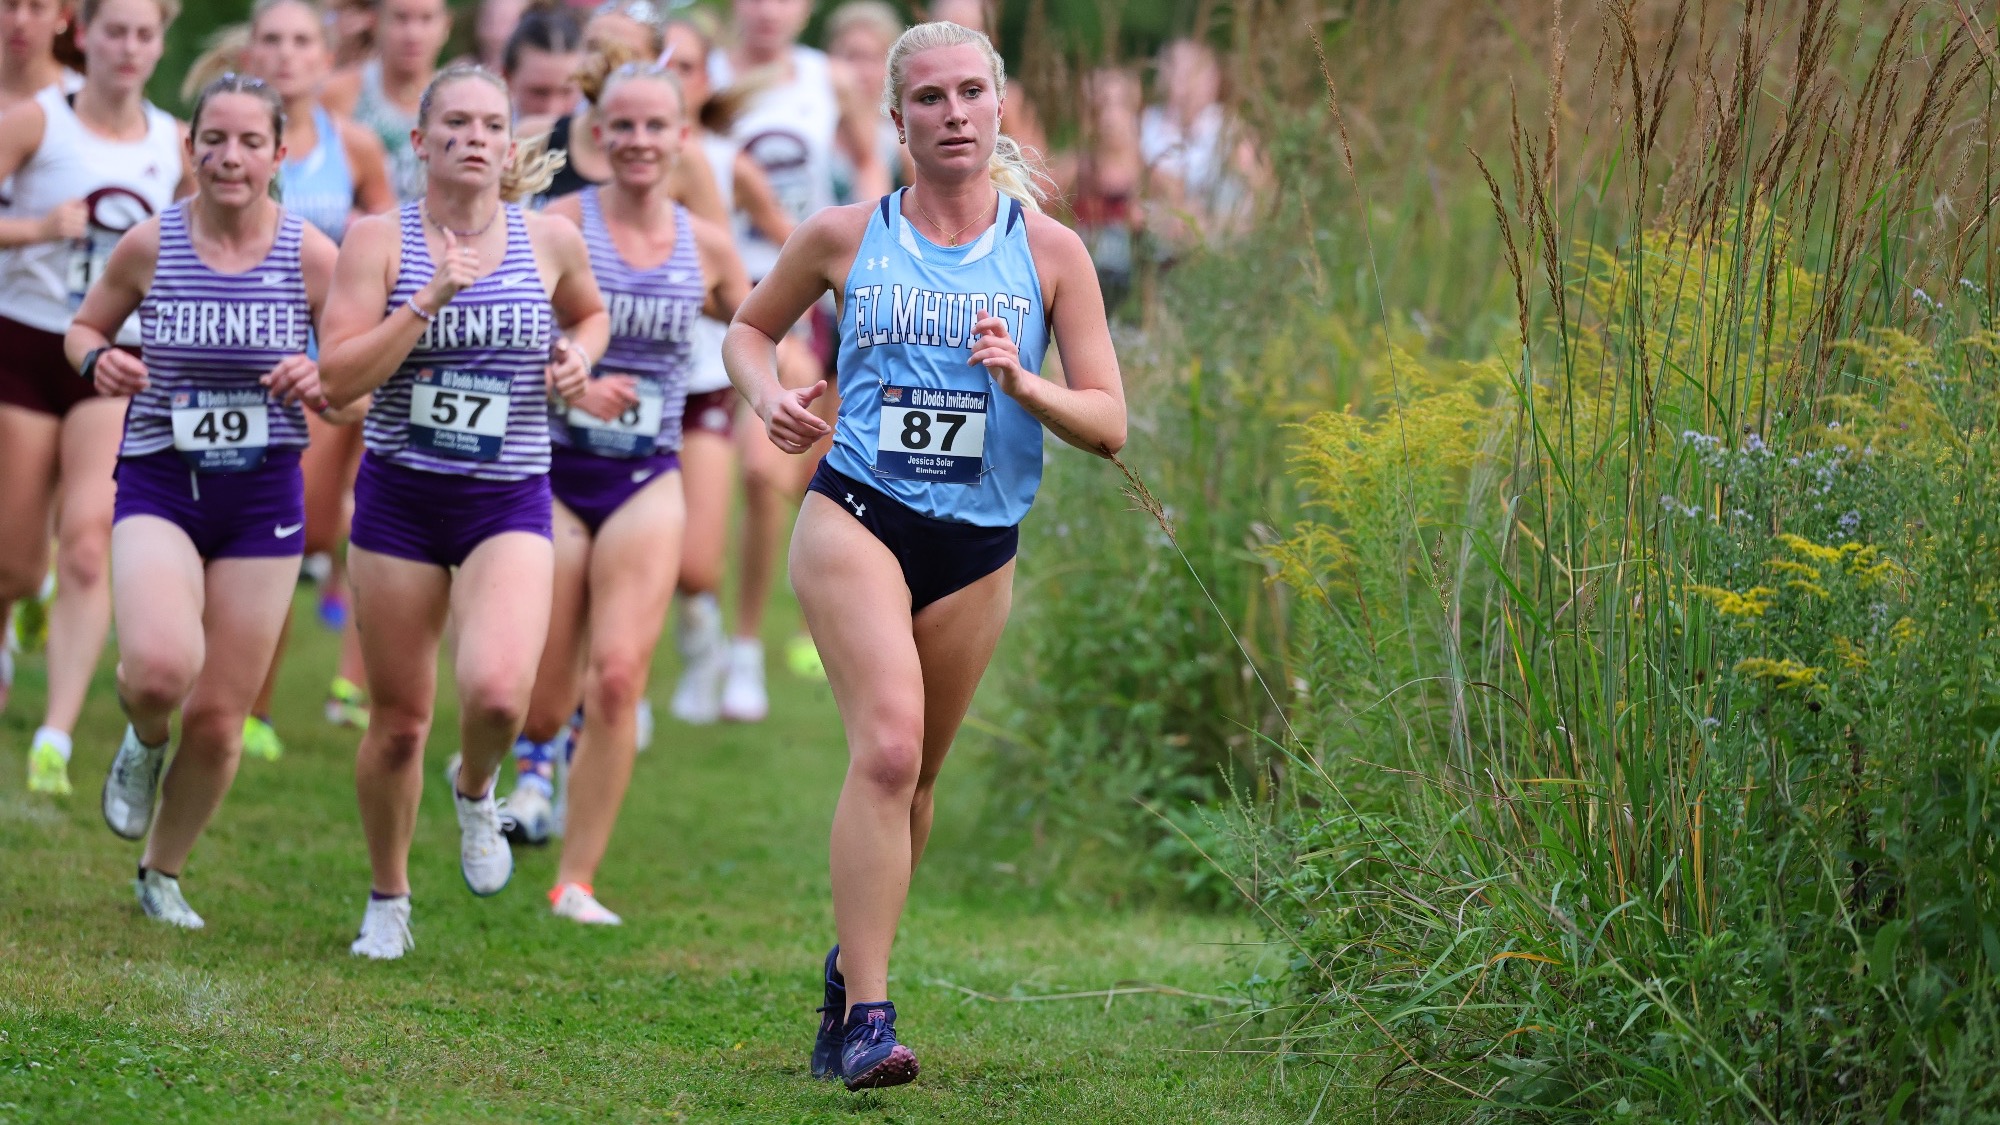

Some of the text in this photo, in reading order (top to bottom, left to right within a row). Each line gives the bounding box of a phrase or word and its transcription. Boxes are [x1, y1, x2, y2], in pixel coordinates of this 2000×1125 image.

[155, 301, 300, 349] CORNELL
[415, 303, 541, 349] RNELL
[854, 284, 1031, 354] ELMHURST
[431, 391, 491, 428] 57
[911, 389, 921, 406] Gil
[922, 390, 944, 408] Dodds
[946, 391, 985, 410] Invitational
[193, 411, 248, 443] 49
[900, 410, 967, 452] 87
[907, 455, 954, 467] Jessica Solar
[915, 467, 947, 475] Elmhurst
